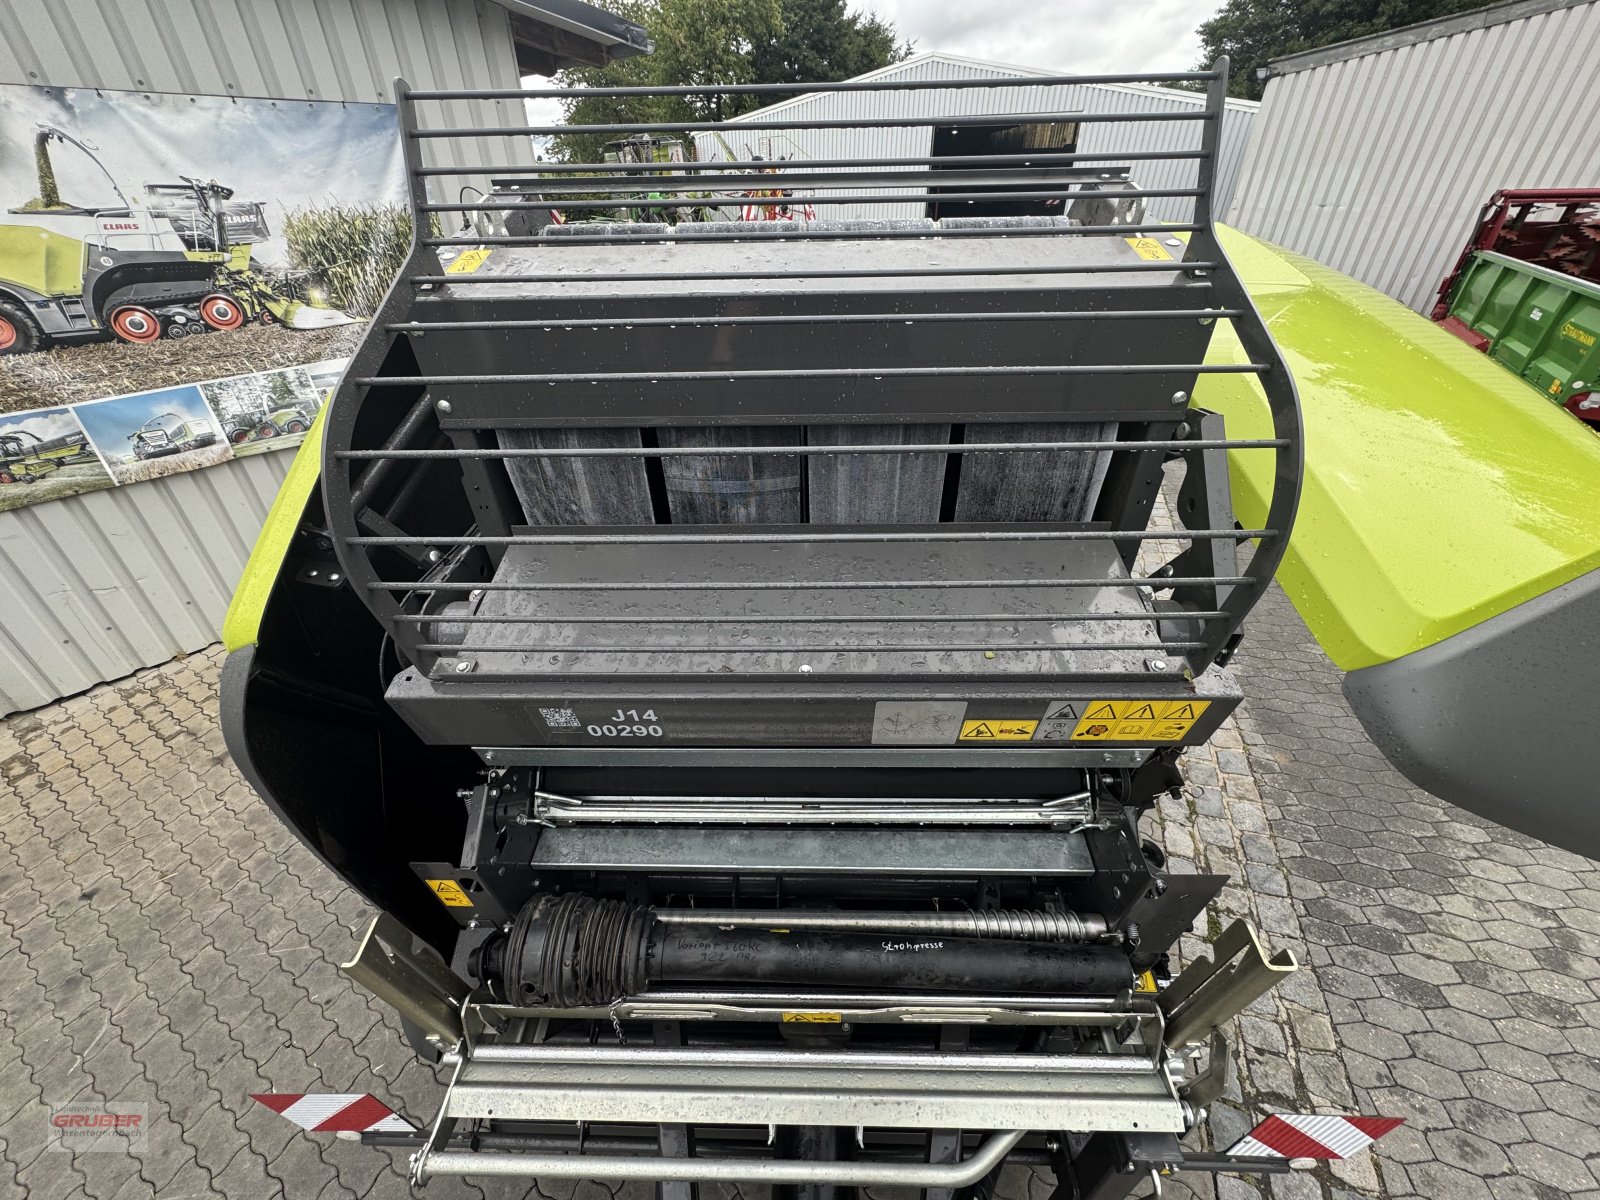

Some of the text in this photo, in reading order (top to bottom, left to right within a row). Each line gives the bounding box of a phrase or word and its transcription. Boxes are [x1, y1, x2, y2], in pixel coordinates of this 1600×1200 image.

[103, 223, 139, 231] CLAAS
[611, 708, 658, 722] J14
[586, 724, 663, 737] 00290
[881, 941, 944, 953] Strohpresse
